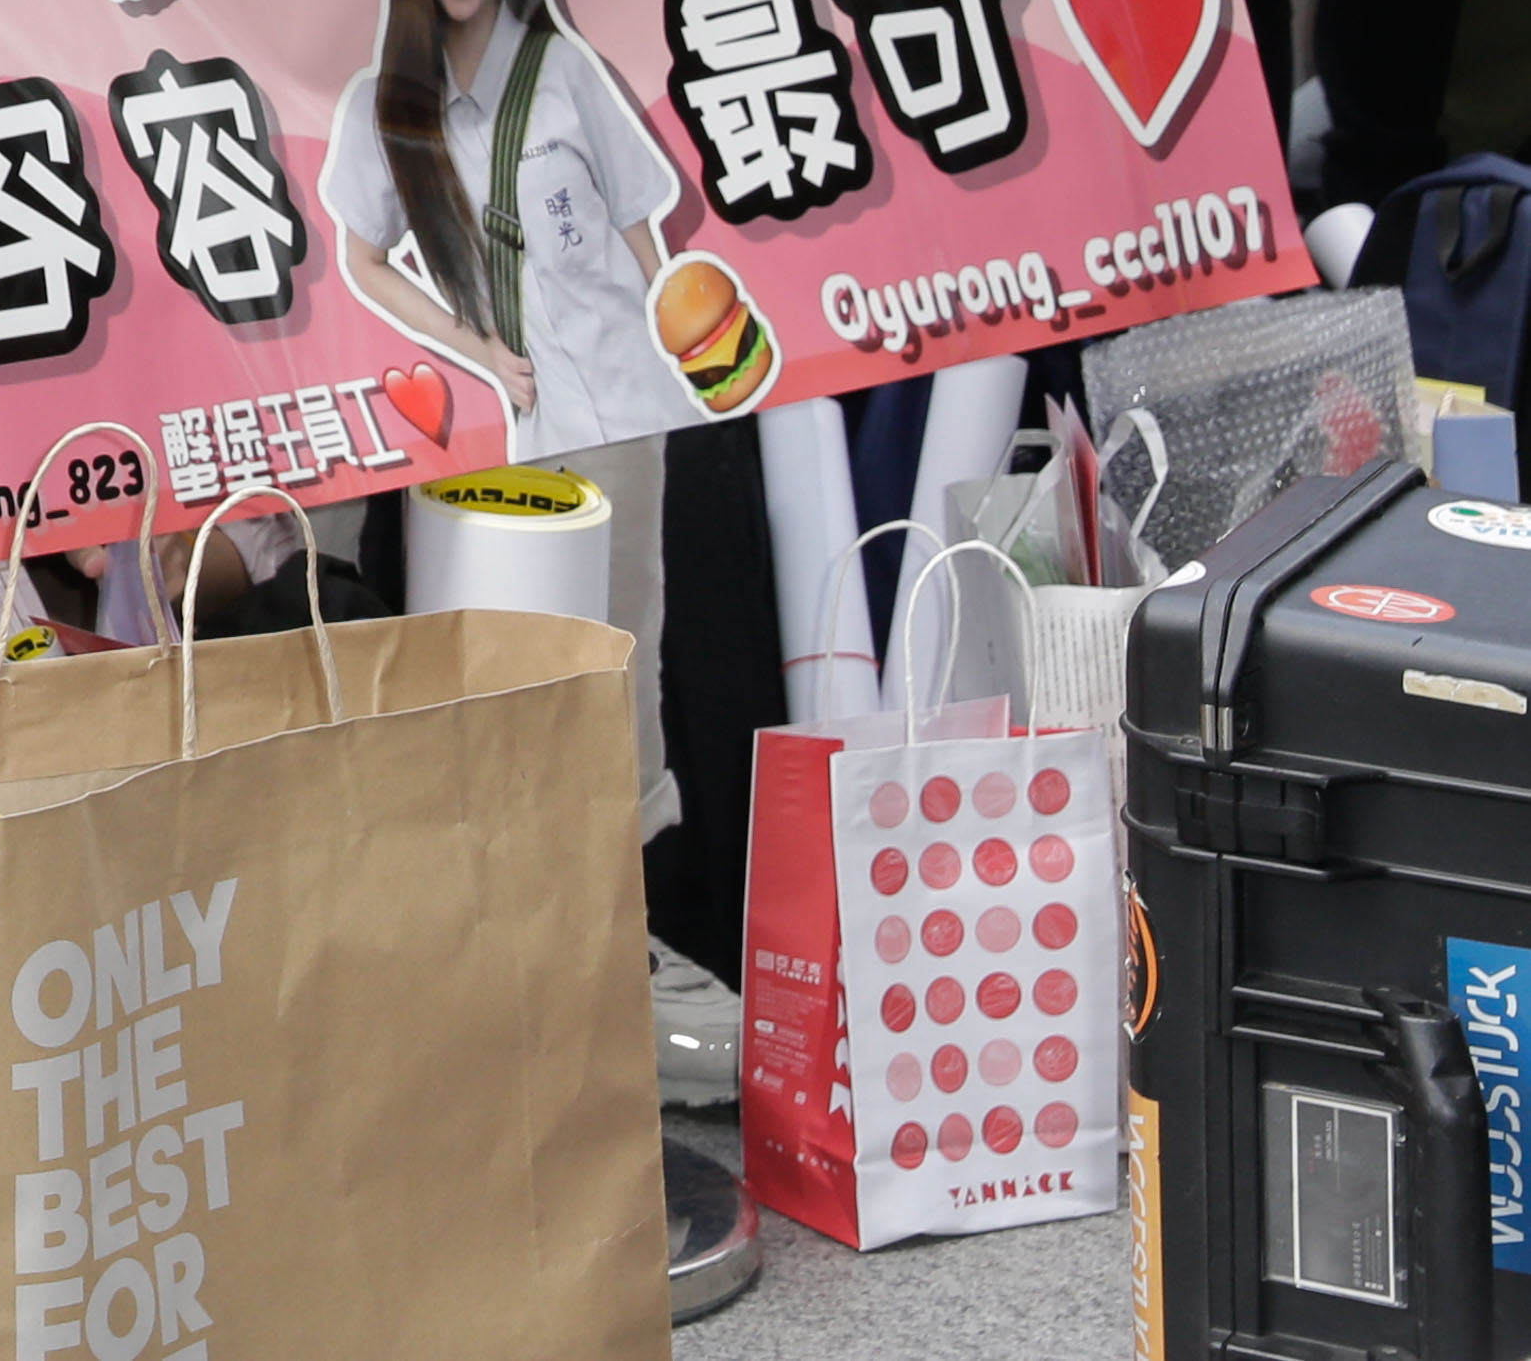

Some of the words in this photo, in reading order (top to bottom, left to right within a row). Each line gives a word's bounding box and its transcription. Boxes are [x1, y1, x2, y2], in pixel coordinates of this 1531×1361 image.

[821, 187, 1265, 352] @yurong_ccc1107
[160, 377, 406, 507] 蟹堡王員工
[11, 877, 239, 1048] ONLY
[11, 1007, 188, 1161] THE
[12, 1099, 245, 1275] BEST
[12, 1232, 213, 1361] FOR
